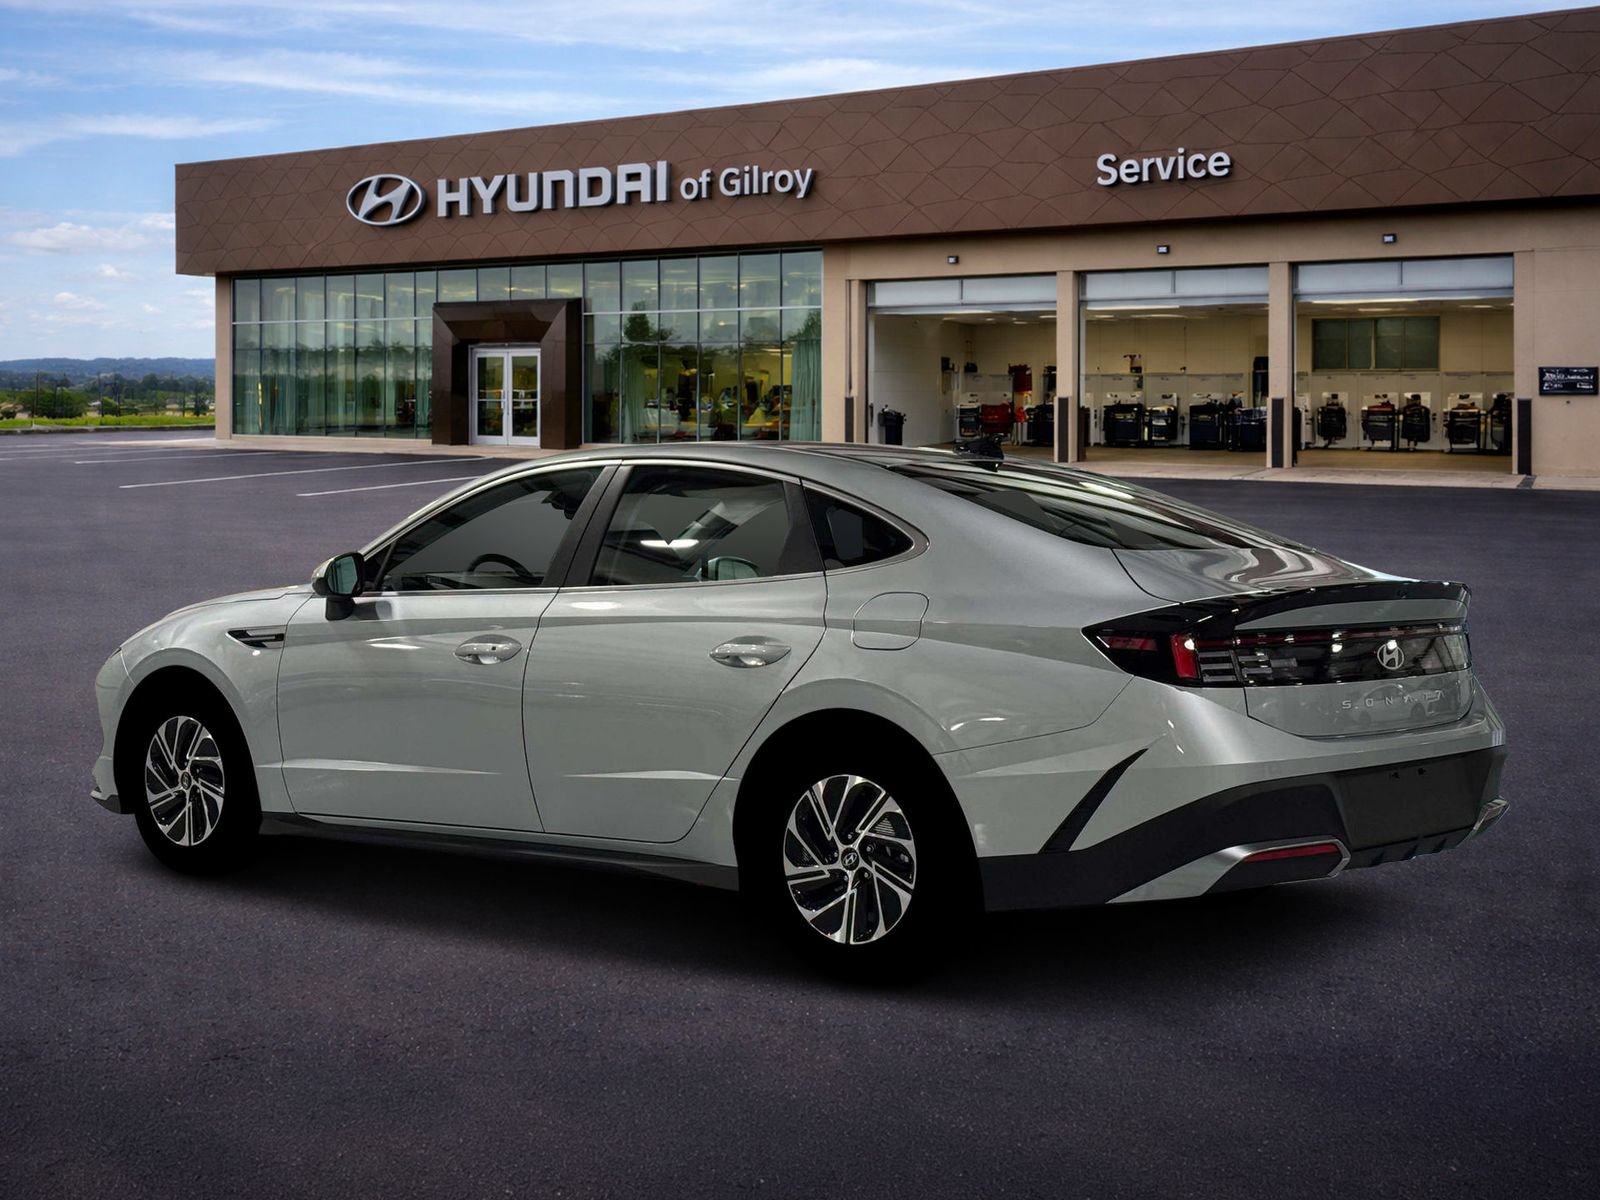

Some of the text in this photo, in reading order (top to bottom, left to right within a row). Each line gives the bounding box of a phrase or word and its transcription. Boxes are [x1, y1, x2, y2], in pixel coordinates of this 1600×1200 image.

[436, 160, 813, 218] HYUNDAI of Gilroy
[1096, 147, 1232, 186] Service
